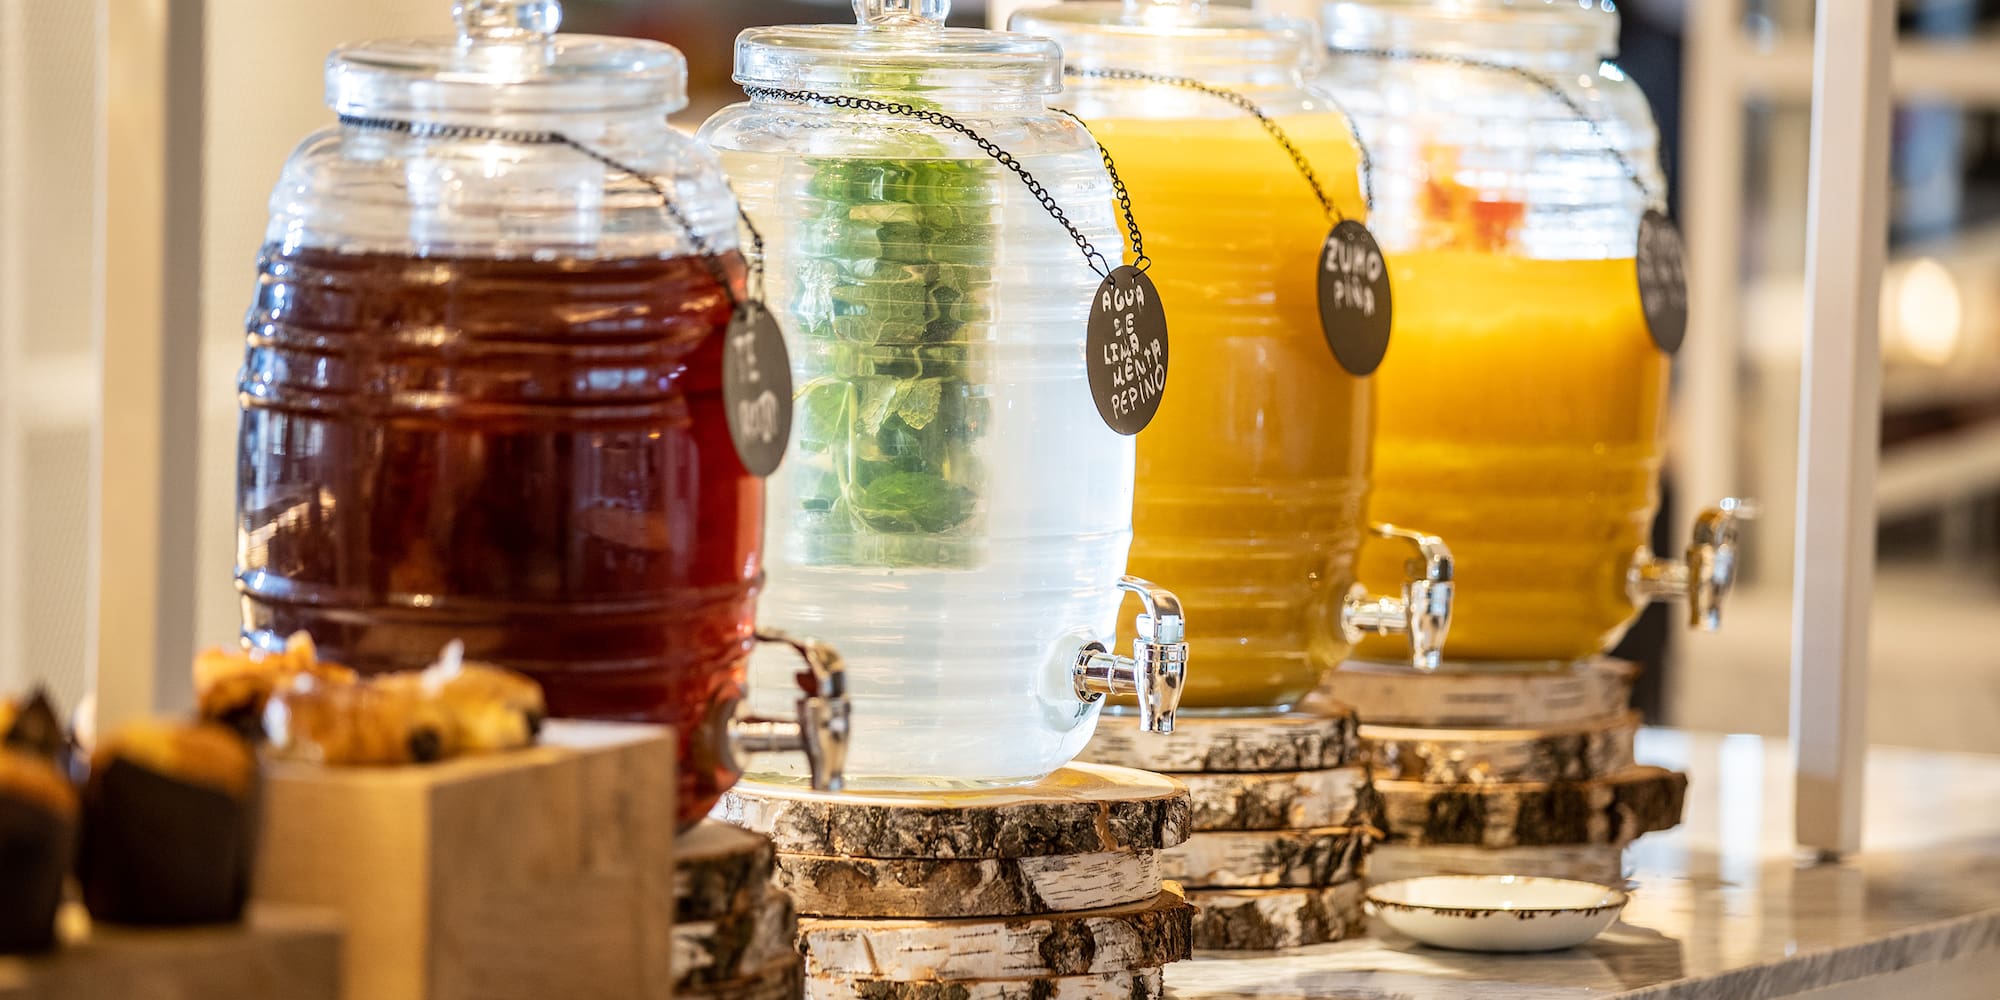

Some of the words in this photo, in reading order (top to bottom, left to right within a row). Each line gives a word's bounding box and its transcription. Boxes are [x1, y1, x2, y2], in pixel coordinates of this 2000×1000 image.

[1325, 237, 1382, 283] ZUMO
[1102, 284, 1145, 313] AGUA
[1103, 332, 1141, 365] LIMA
[1113, 338, 1162, 388] MENTA
[1111, 363, 1166, 420] PEPINO
